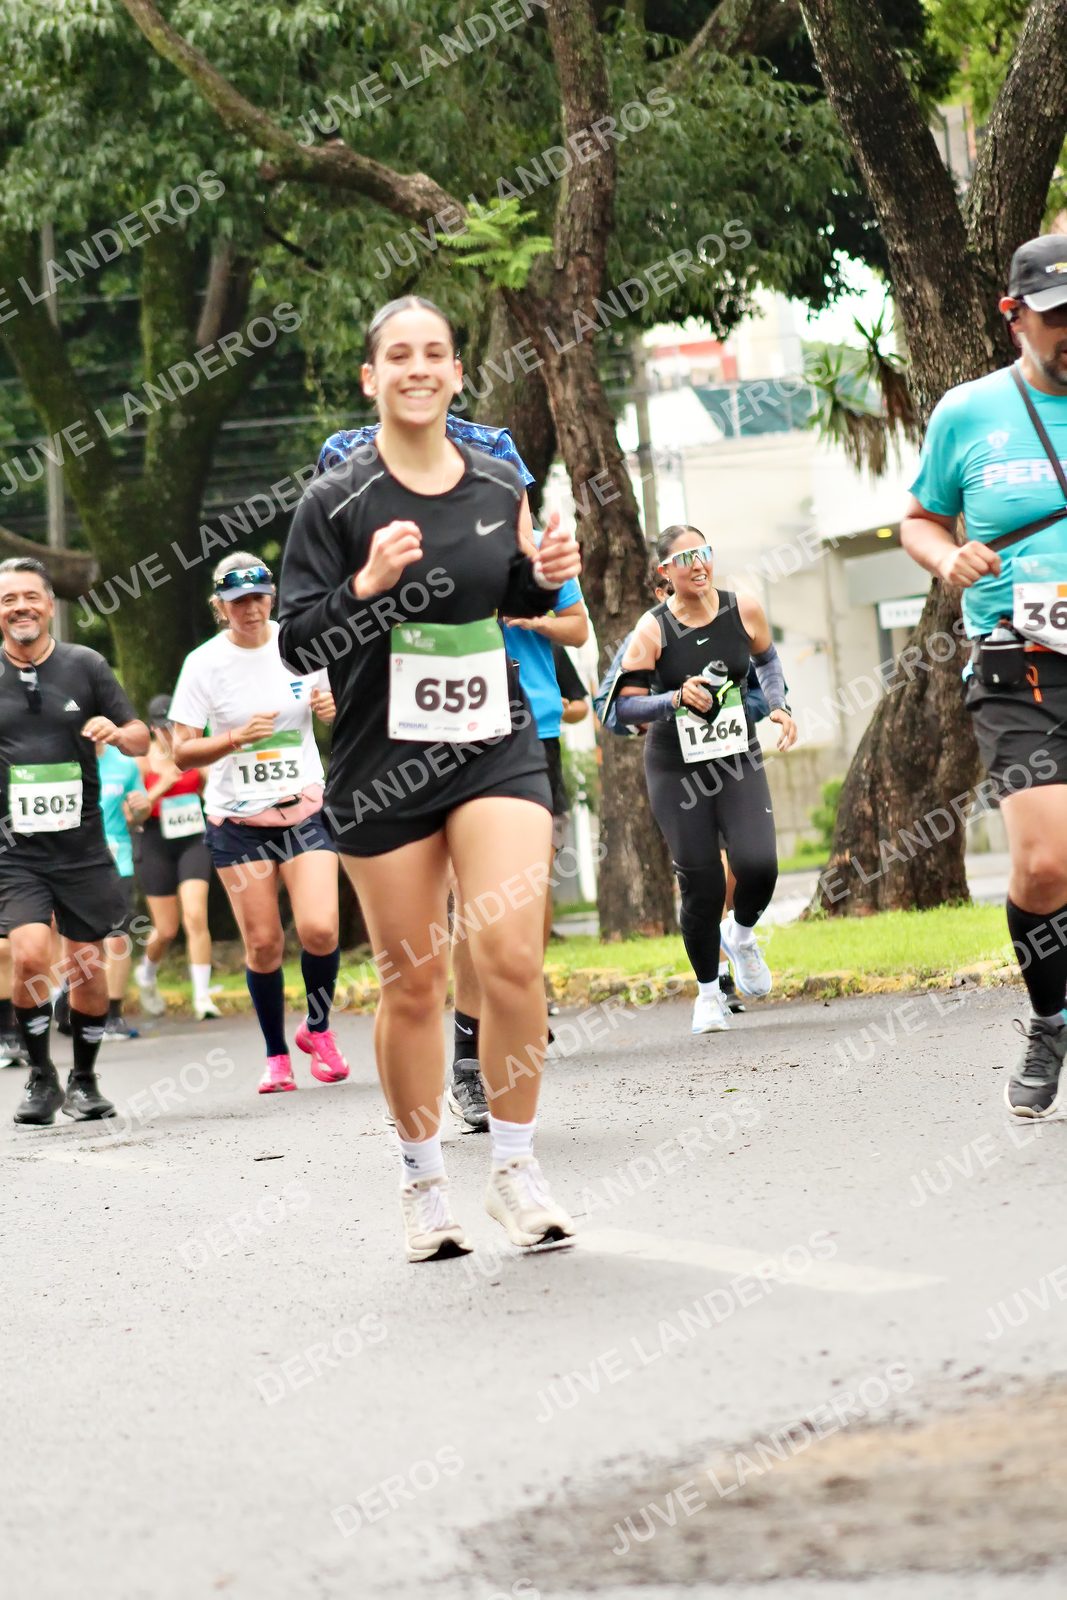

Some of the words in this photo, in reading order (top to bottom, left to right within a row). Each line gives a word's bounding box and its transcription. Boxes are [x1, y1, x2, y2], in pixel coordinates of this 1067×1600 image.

[1023, 601, 1067, 632] 36
[415, 676, 487, 713] 659
[685, 719, 742, 745] 1264
[239, 760, 299, 784] 1833
[18, 794, 77, 816] 1803
